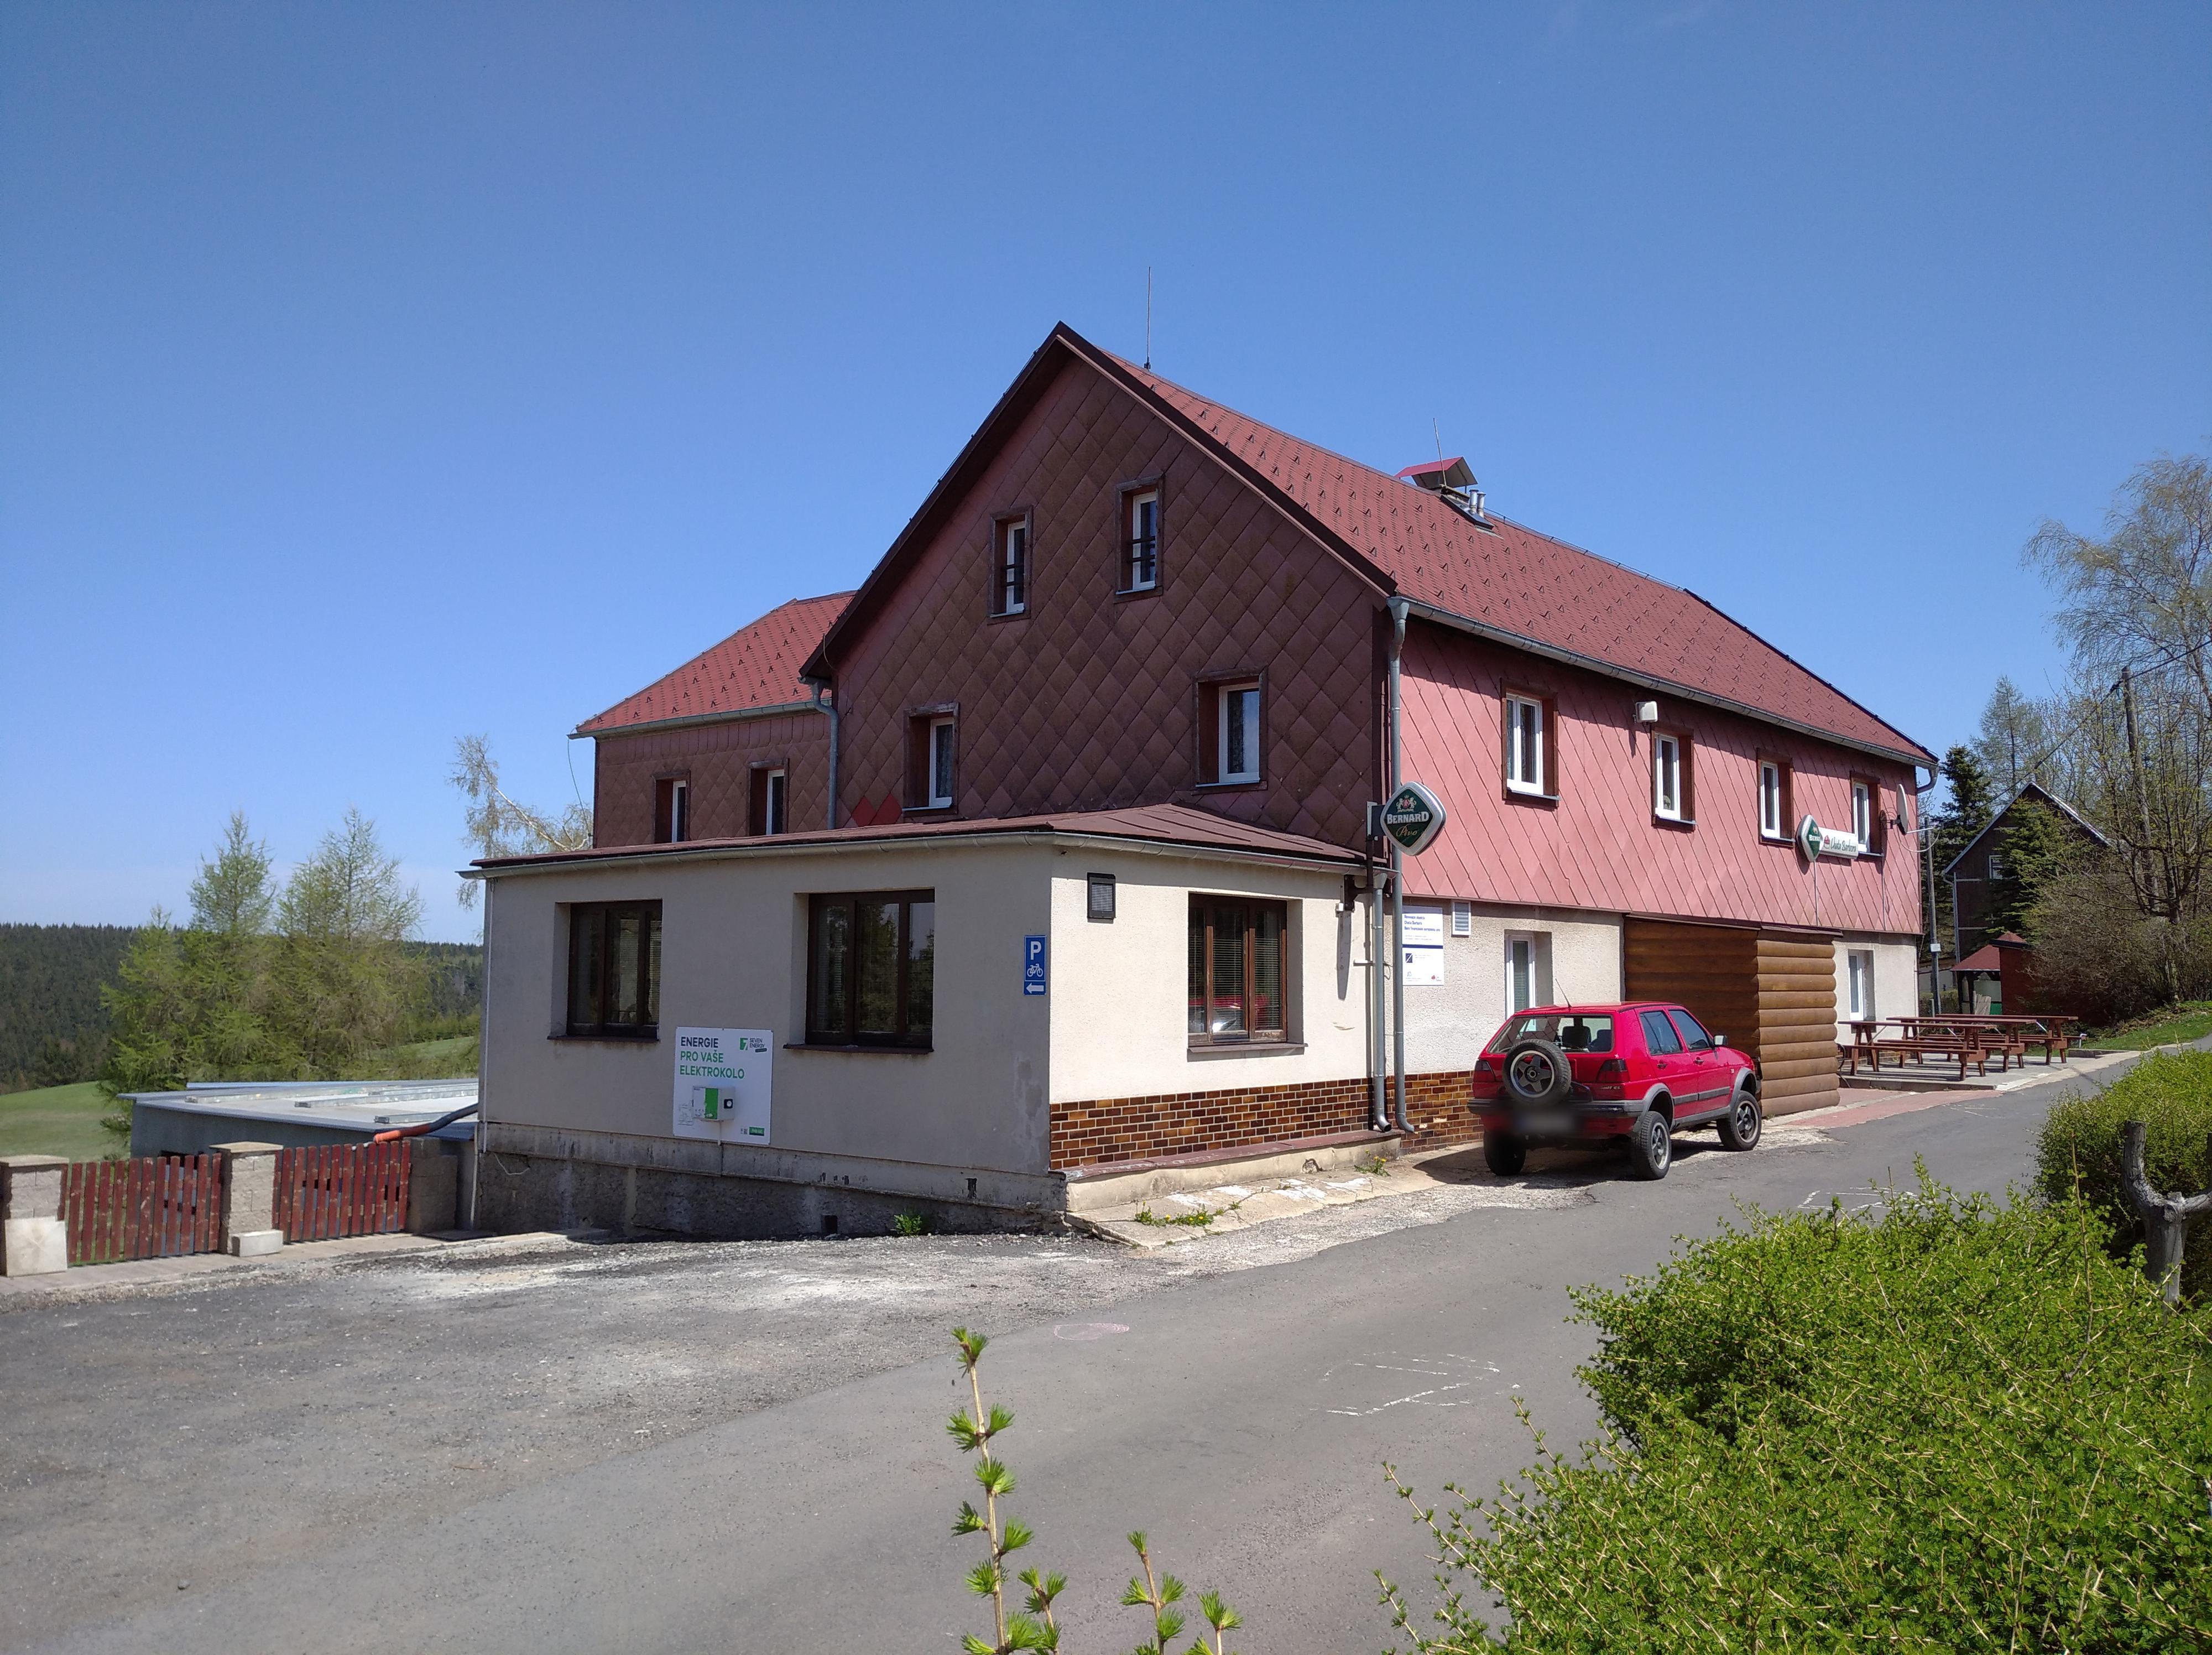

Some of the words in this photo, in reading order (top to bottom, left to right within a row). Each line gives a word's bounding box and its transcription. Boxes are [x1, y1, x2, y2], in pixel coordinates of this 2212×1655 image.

[1386, 811, 1430, 825] BERNARD
[1396, 824, 1418, 837] Pivo
[1030, 941, 1042, 960] P
[681, 1036, 719, 1048] ENERGIE
[680, 1051, 698, 1061] PRO
[701, 1049, 724, 1063] VAŠE
[680, 1065, 745, 1079] ELEKTROKOLO
